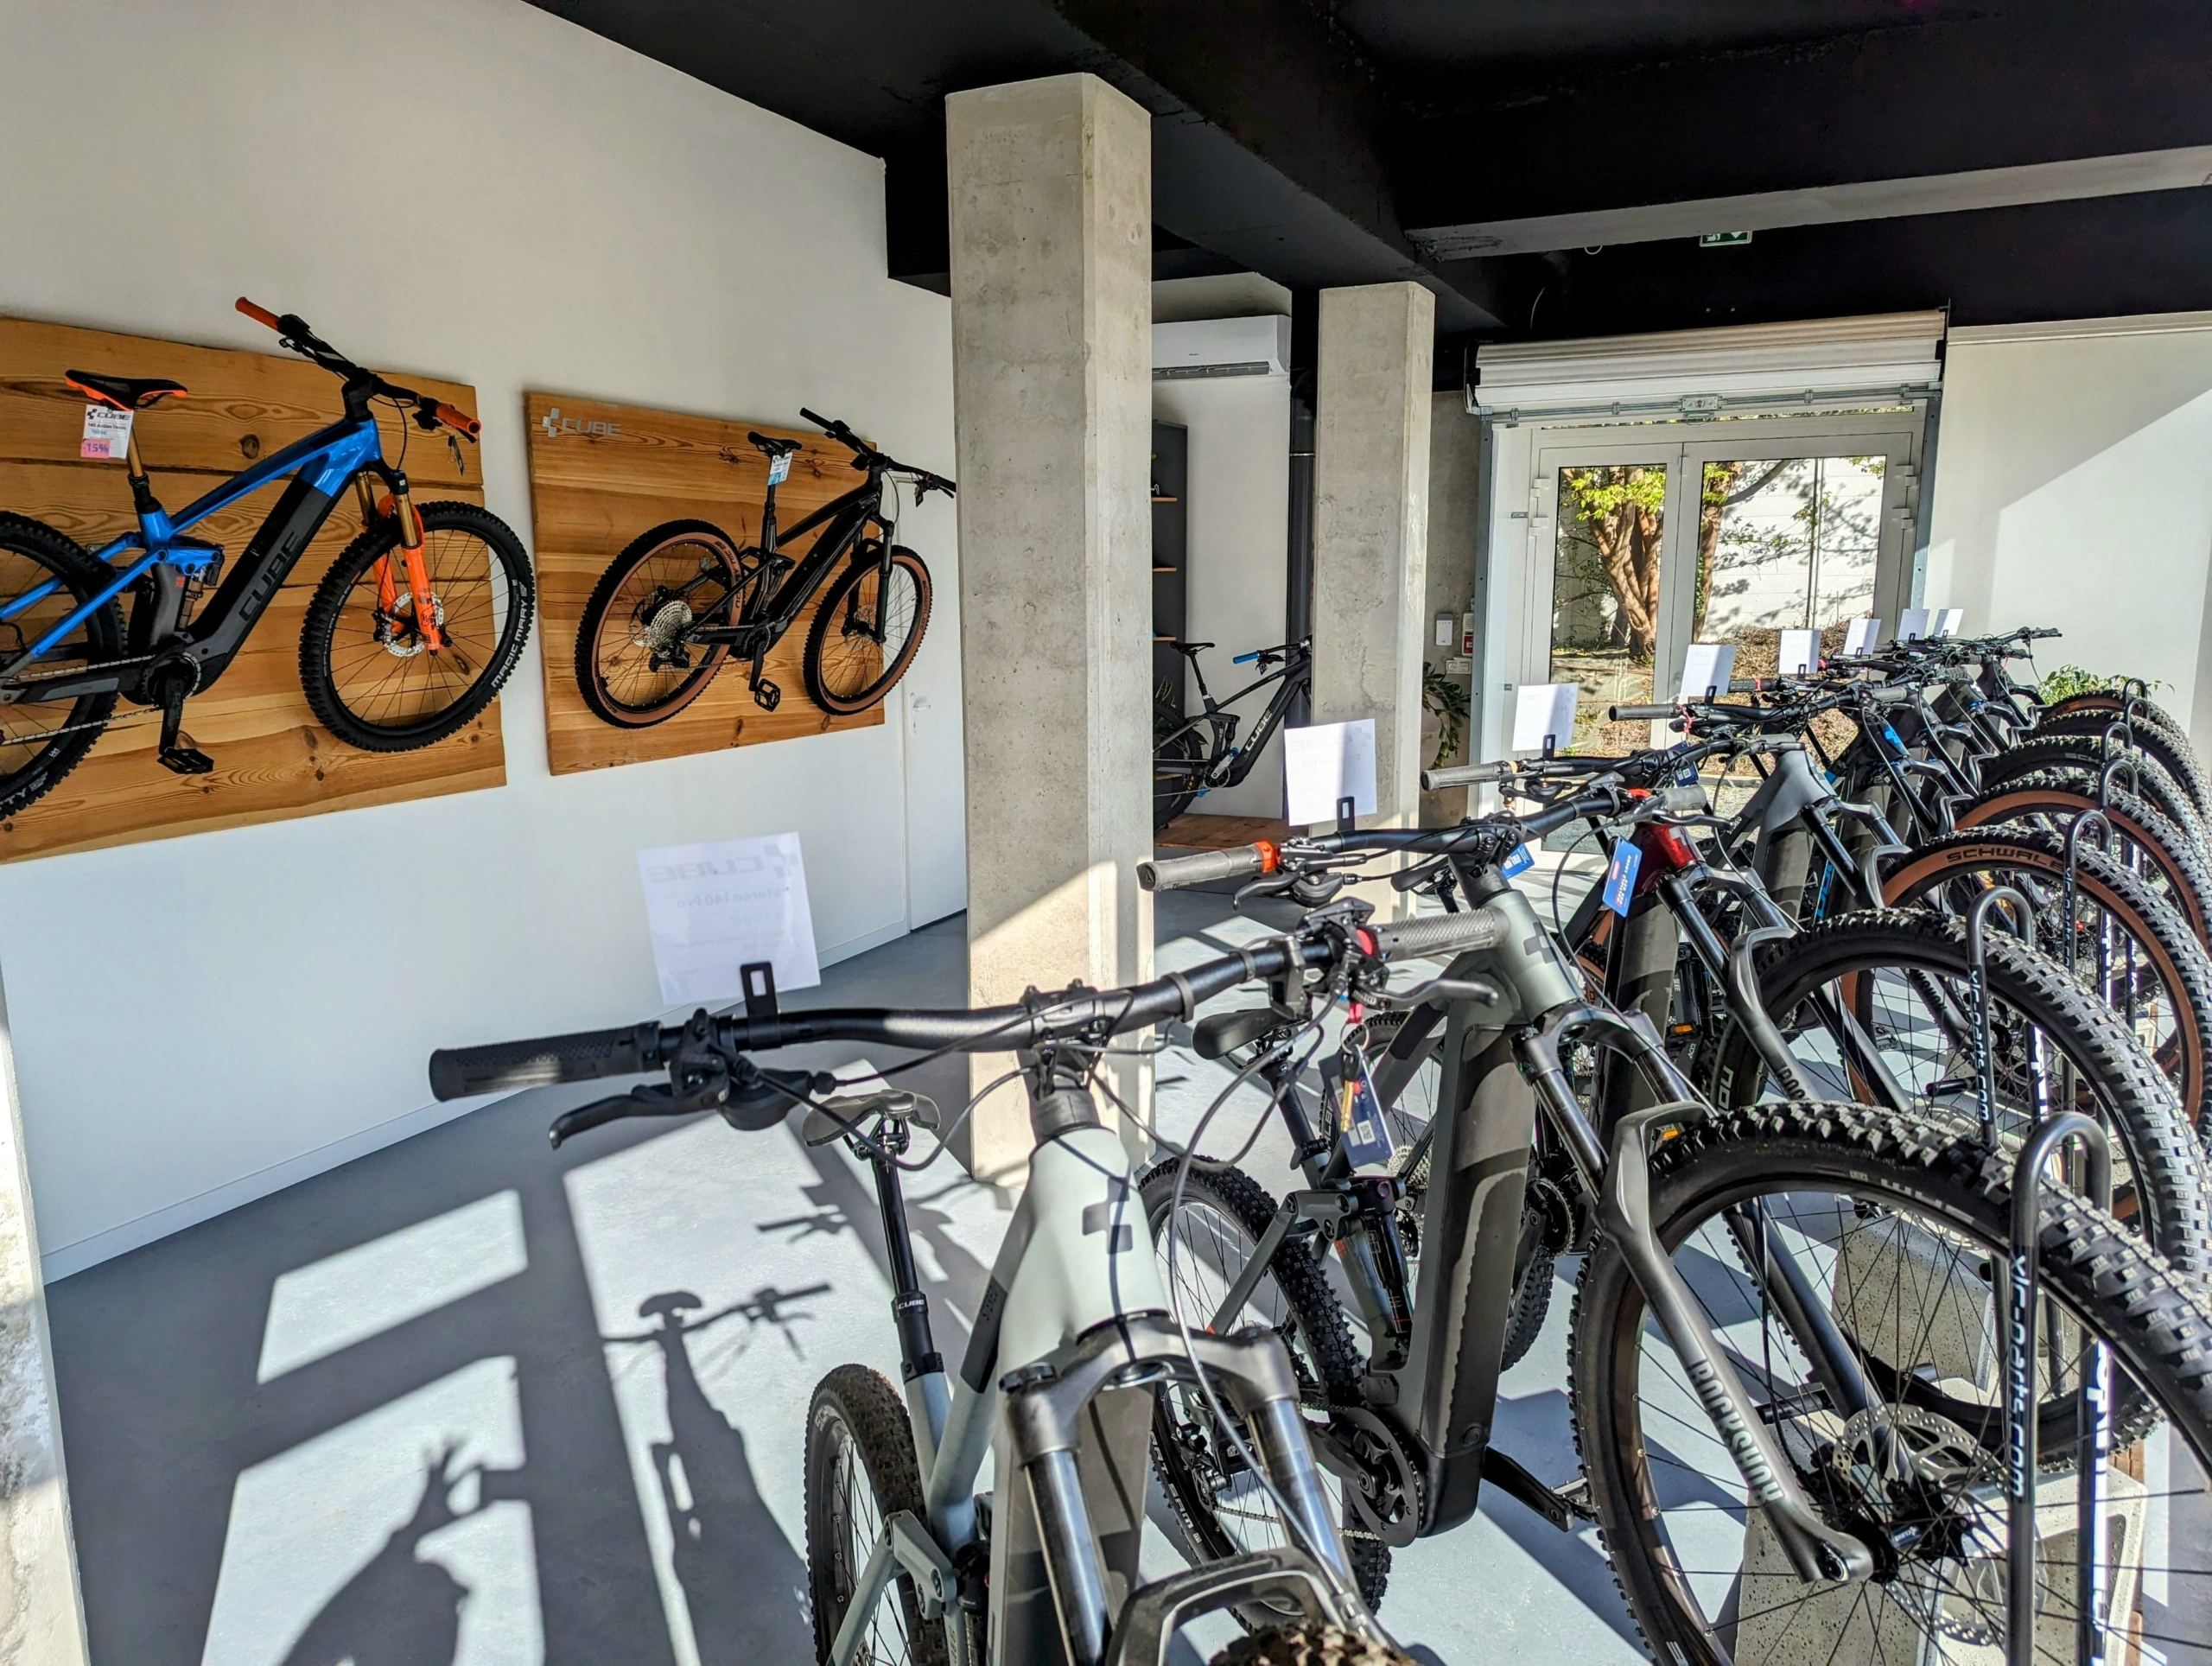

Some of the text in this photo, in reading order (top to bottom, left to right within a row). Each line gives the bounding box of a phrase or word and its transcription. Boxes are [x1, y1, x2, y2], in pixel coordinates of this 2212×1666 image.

[97, 411, 130, 421] CUBE
[562, 417, 621, 436] CUBE
[238, 531, 302, 622] CUBE
[491, 599, 528, 689] MAGIC MARY
[1244, 709, 1273, 752] CUBE
[899, 1299, 925, 1310] CUBE
